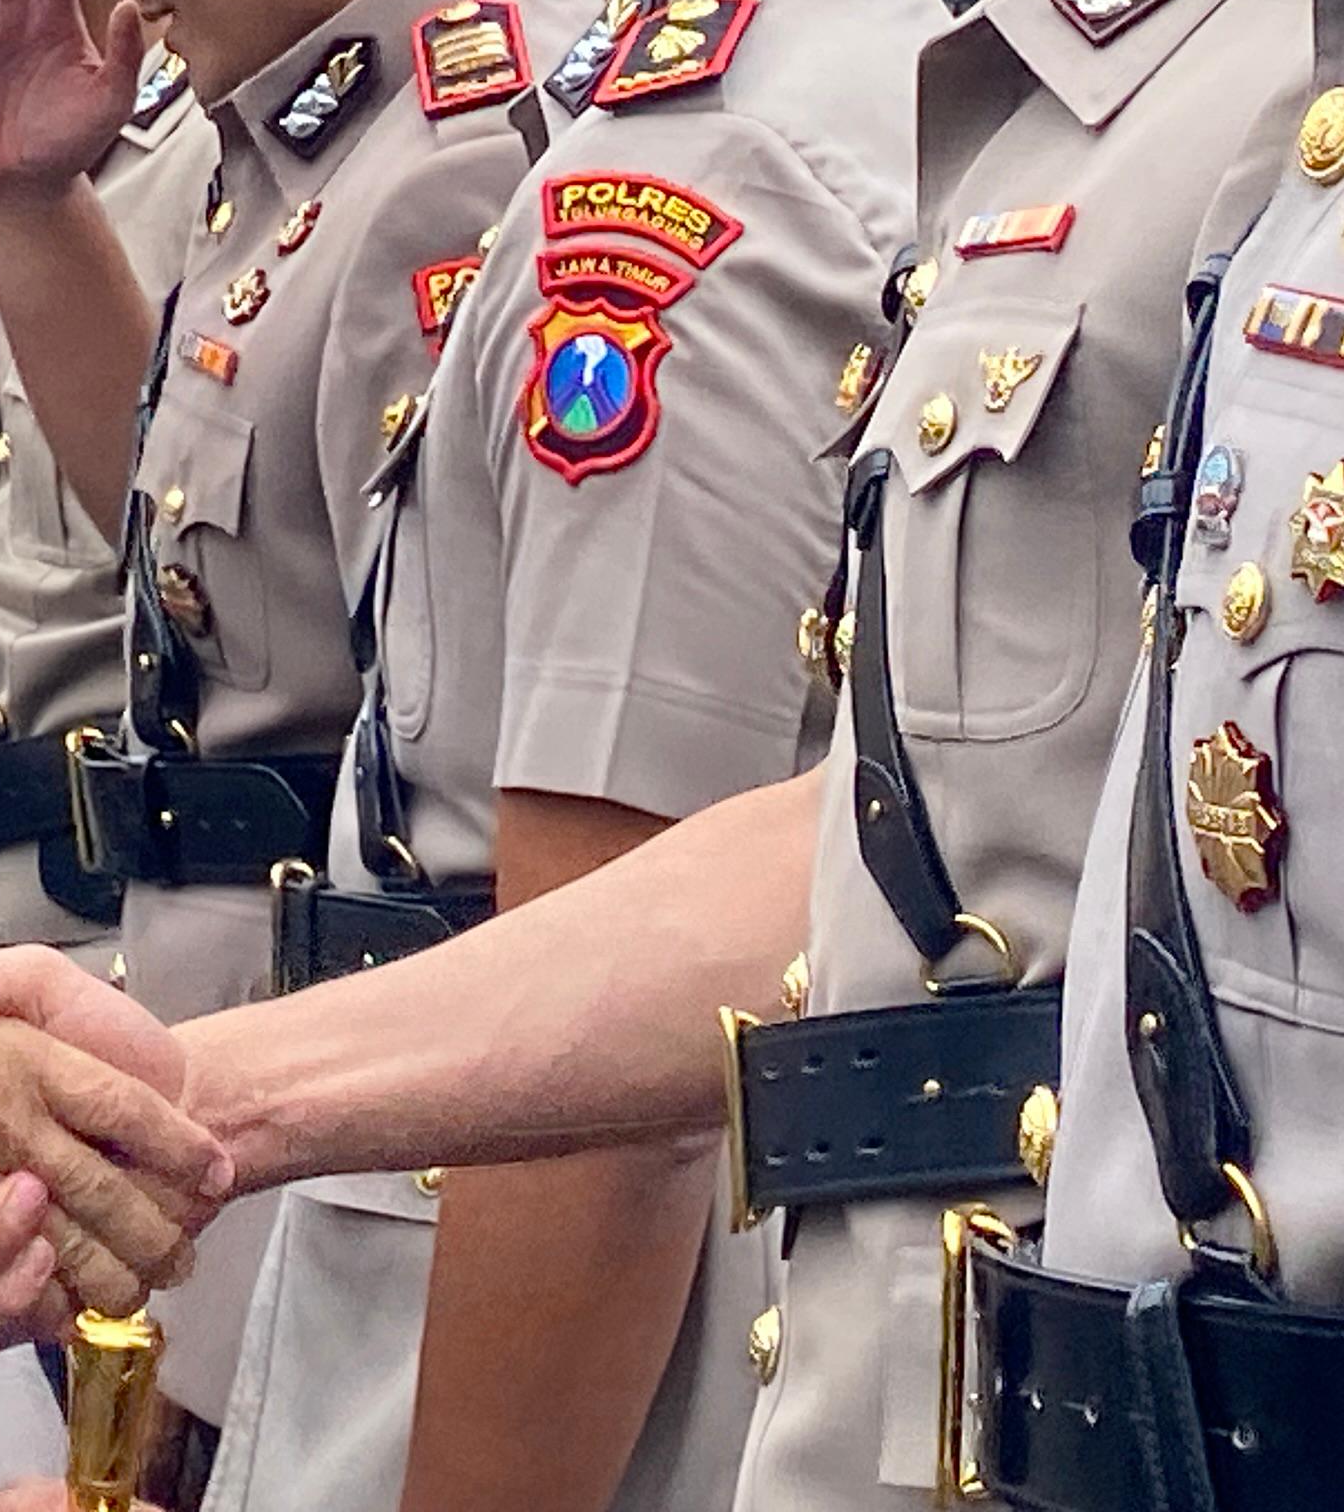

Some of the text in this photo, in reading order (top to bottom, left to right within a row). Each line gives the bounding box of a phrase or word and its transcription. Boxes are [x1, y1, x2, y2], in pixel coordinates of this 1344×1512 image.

[561, 181, 712, 235] POLRES
[555, 257, 671, 293] JAWA TIMUR
